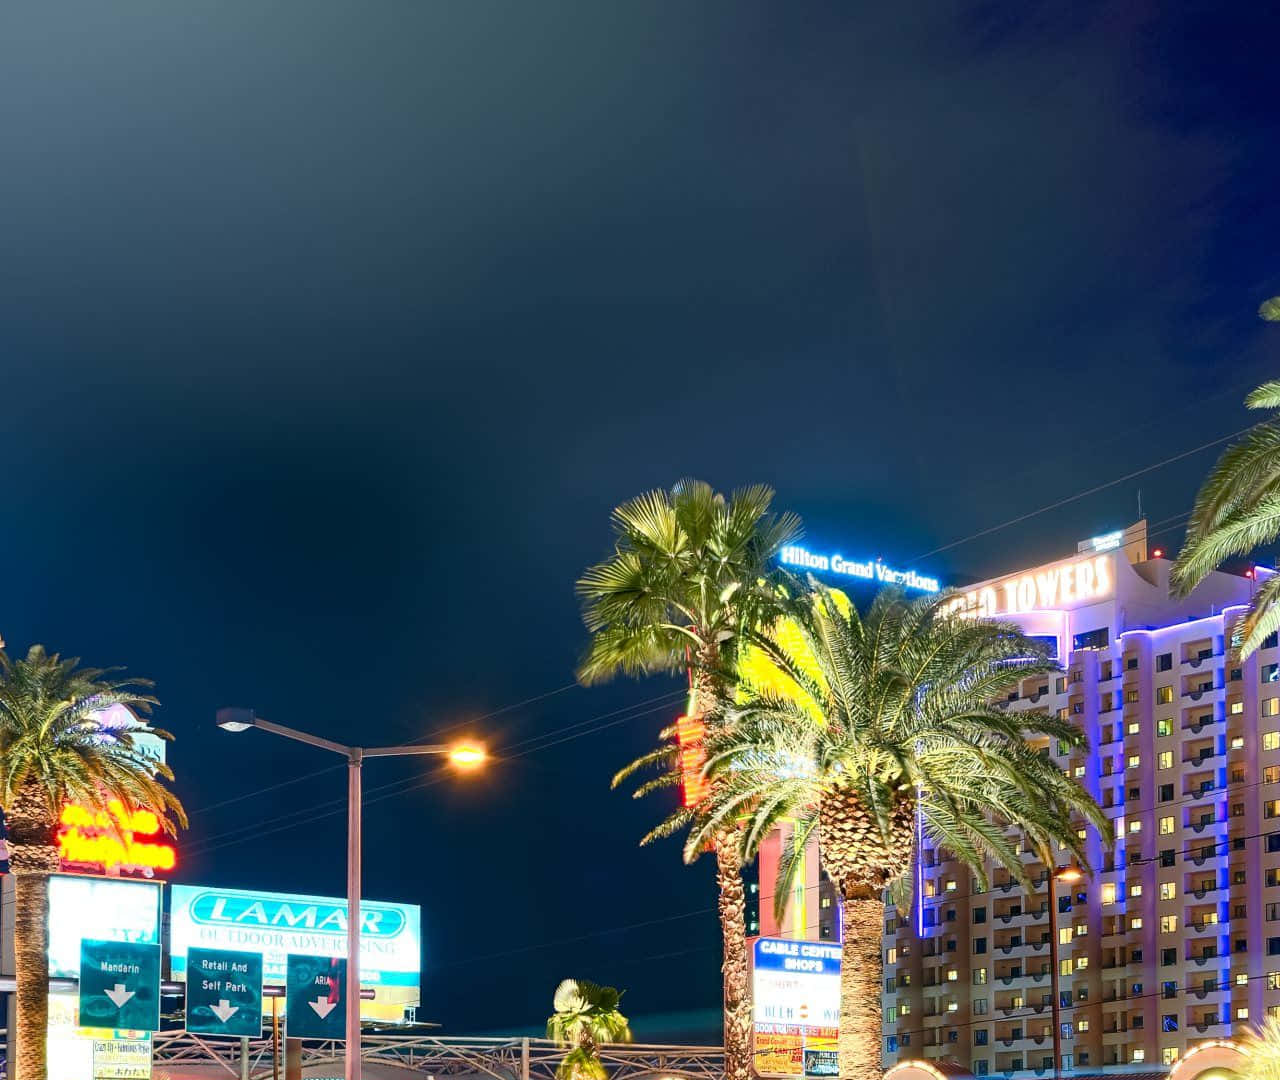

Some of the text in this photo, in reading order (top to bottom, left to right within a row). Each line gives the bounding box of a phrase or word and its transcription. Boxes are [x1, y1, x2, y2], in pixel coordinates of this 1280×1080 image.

[780, 546, 829, 570] Hilton
[831, 554, 872, 579] Grand
[1004, 555, 1109, 612] TOWERS
[209, 896, 385, 933] LAMAR
[801, 944, 842, 959] CENTE
[100, 961, 140, 974] Mandarin
[201, 959, 248, 973] Retail And
[202, 980, 247, 993] Self Park
[314, 975, 331, 986] ARIA
